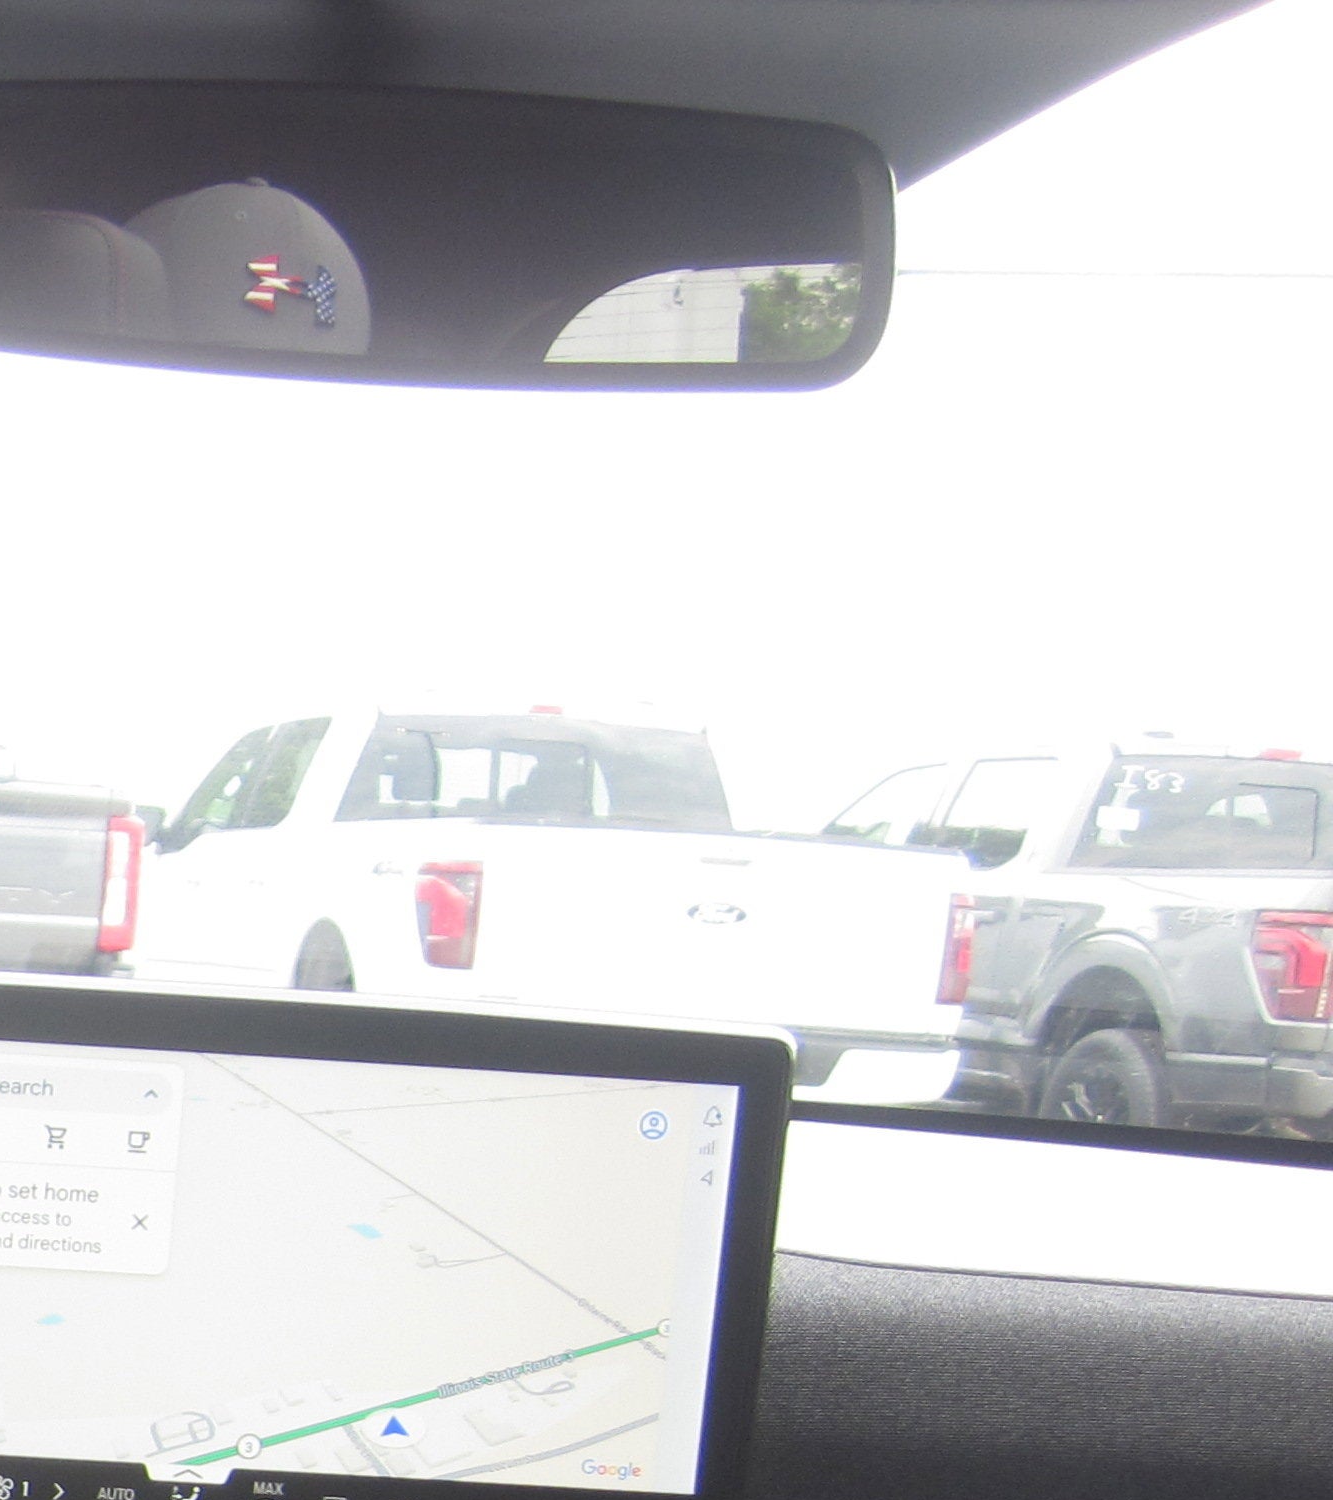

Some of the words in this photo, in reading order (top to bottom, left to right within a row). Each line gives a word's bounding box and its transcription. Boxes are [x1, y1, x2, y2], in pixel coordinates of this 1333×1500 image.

[9, 1182, 38, 1201] set
[44, 1183, 99, 1204] home
[55, 1211, 72, 1227] to
[18, 1233, 102, 1254] directions
[438, 1376, 482, 1398] Illinois
[485, 1369, 519, 1386] State
[521, 1354, 562, 1374] Route
[581, 1458, 642, 1480] Google
[253, 1481, 284, 1497] MAX
